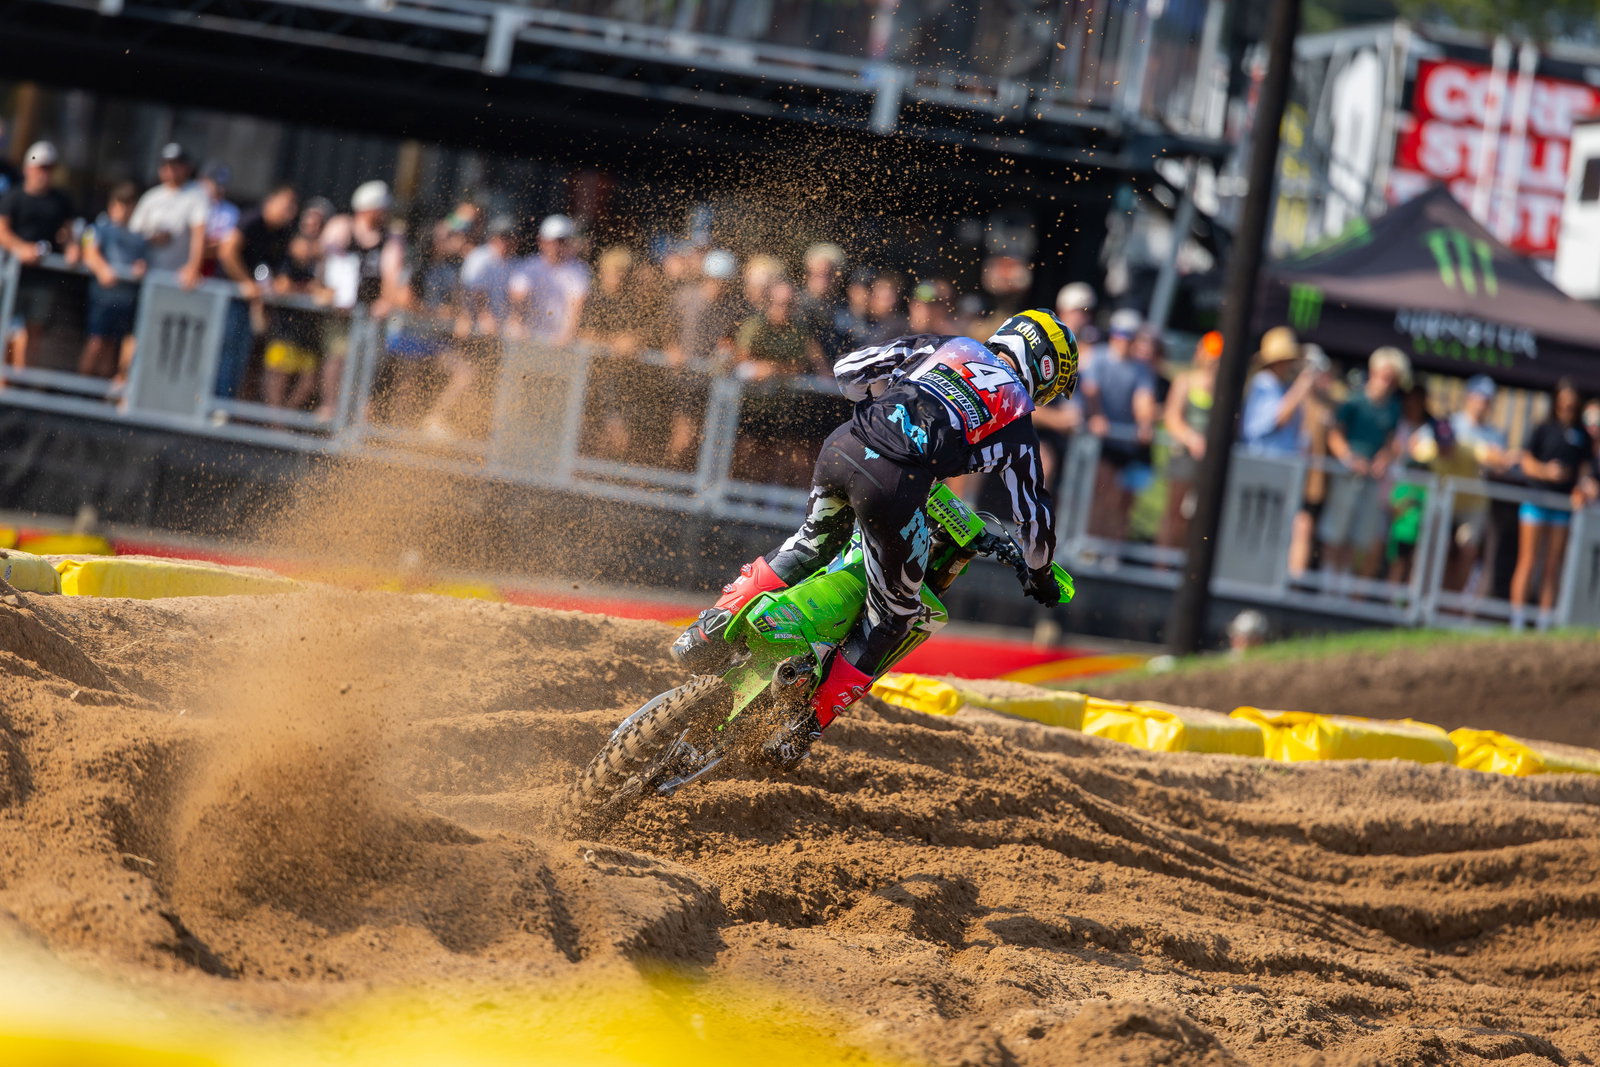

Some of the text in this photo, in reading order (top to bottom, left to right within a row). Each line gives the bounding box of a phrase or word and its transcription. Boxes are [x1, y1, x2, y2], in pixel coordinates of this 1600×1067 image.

[1014, 321, 1041, 350] KADE
[963, 361, 1016, 393] 4
[1043, 359, 1051, 377] BELL
[922, 373, 979, 425] CHAMPIONSHIP
[928, 503, 967, 541] RENTHAL
[933, 498, 972, 536] RENTHAL
[682, 642, 698, 655] FOX
